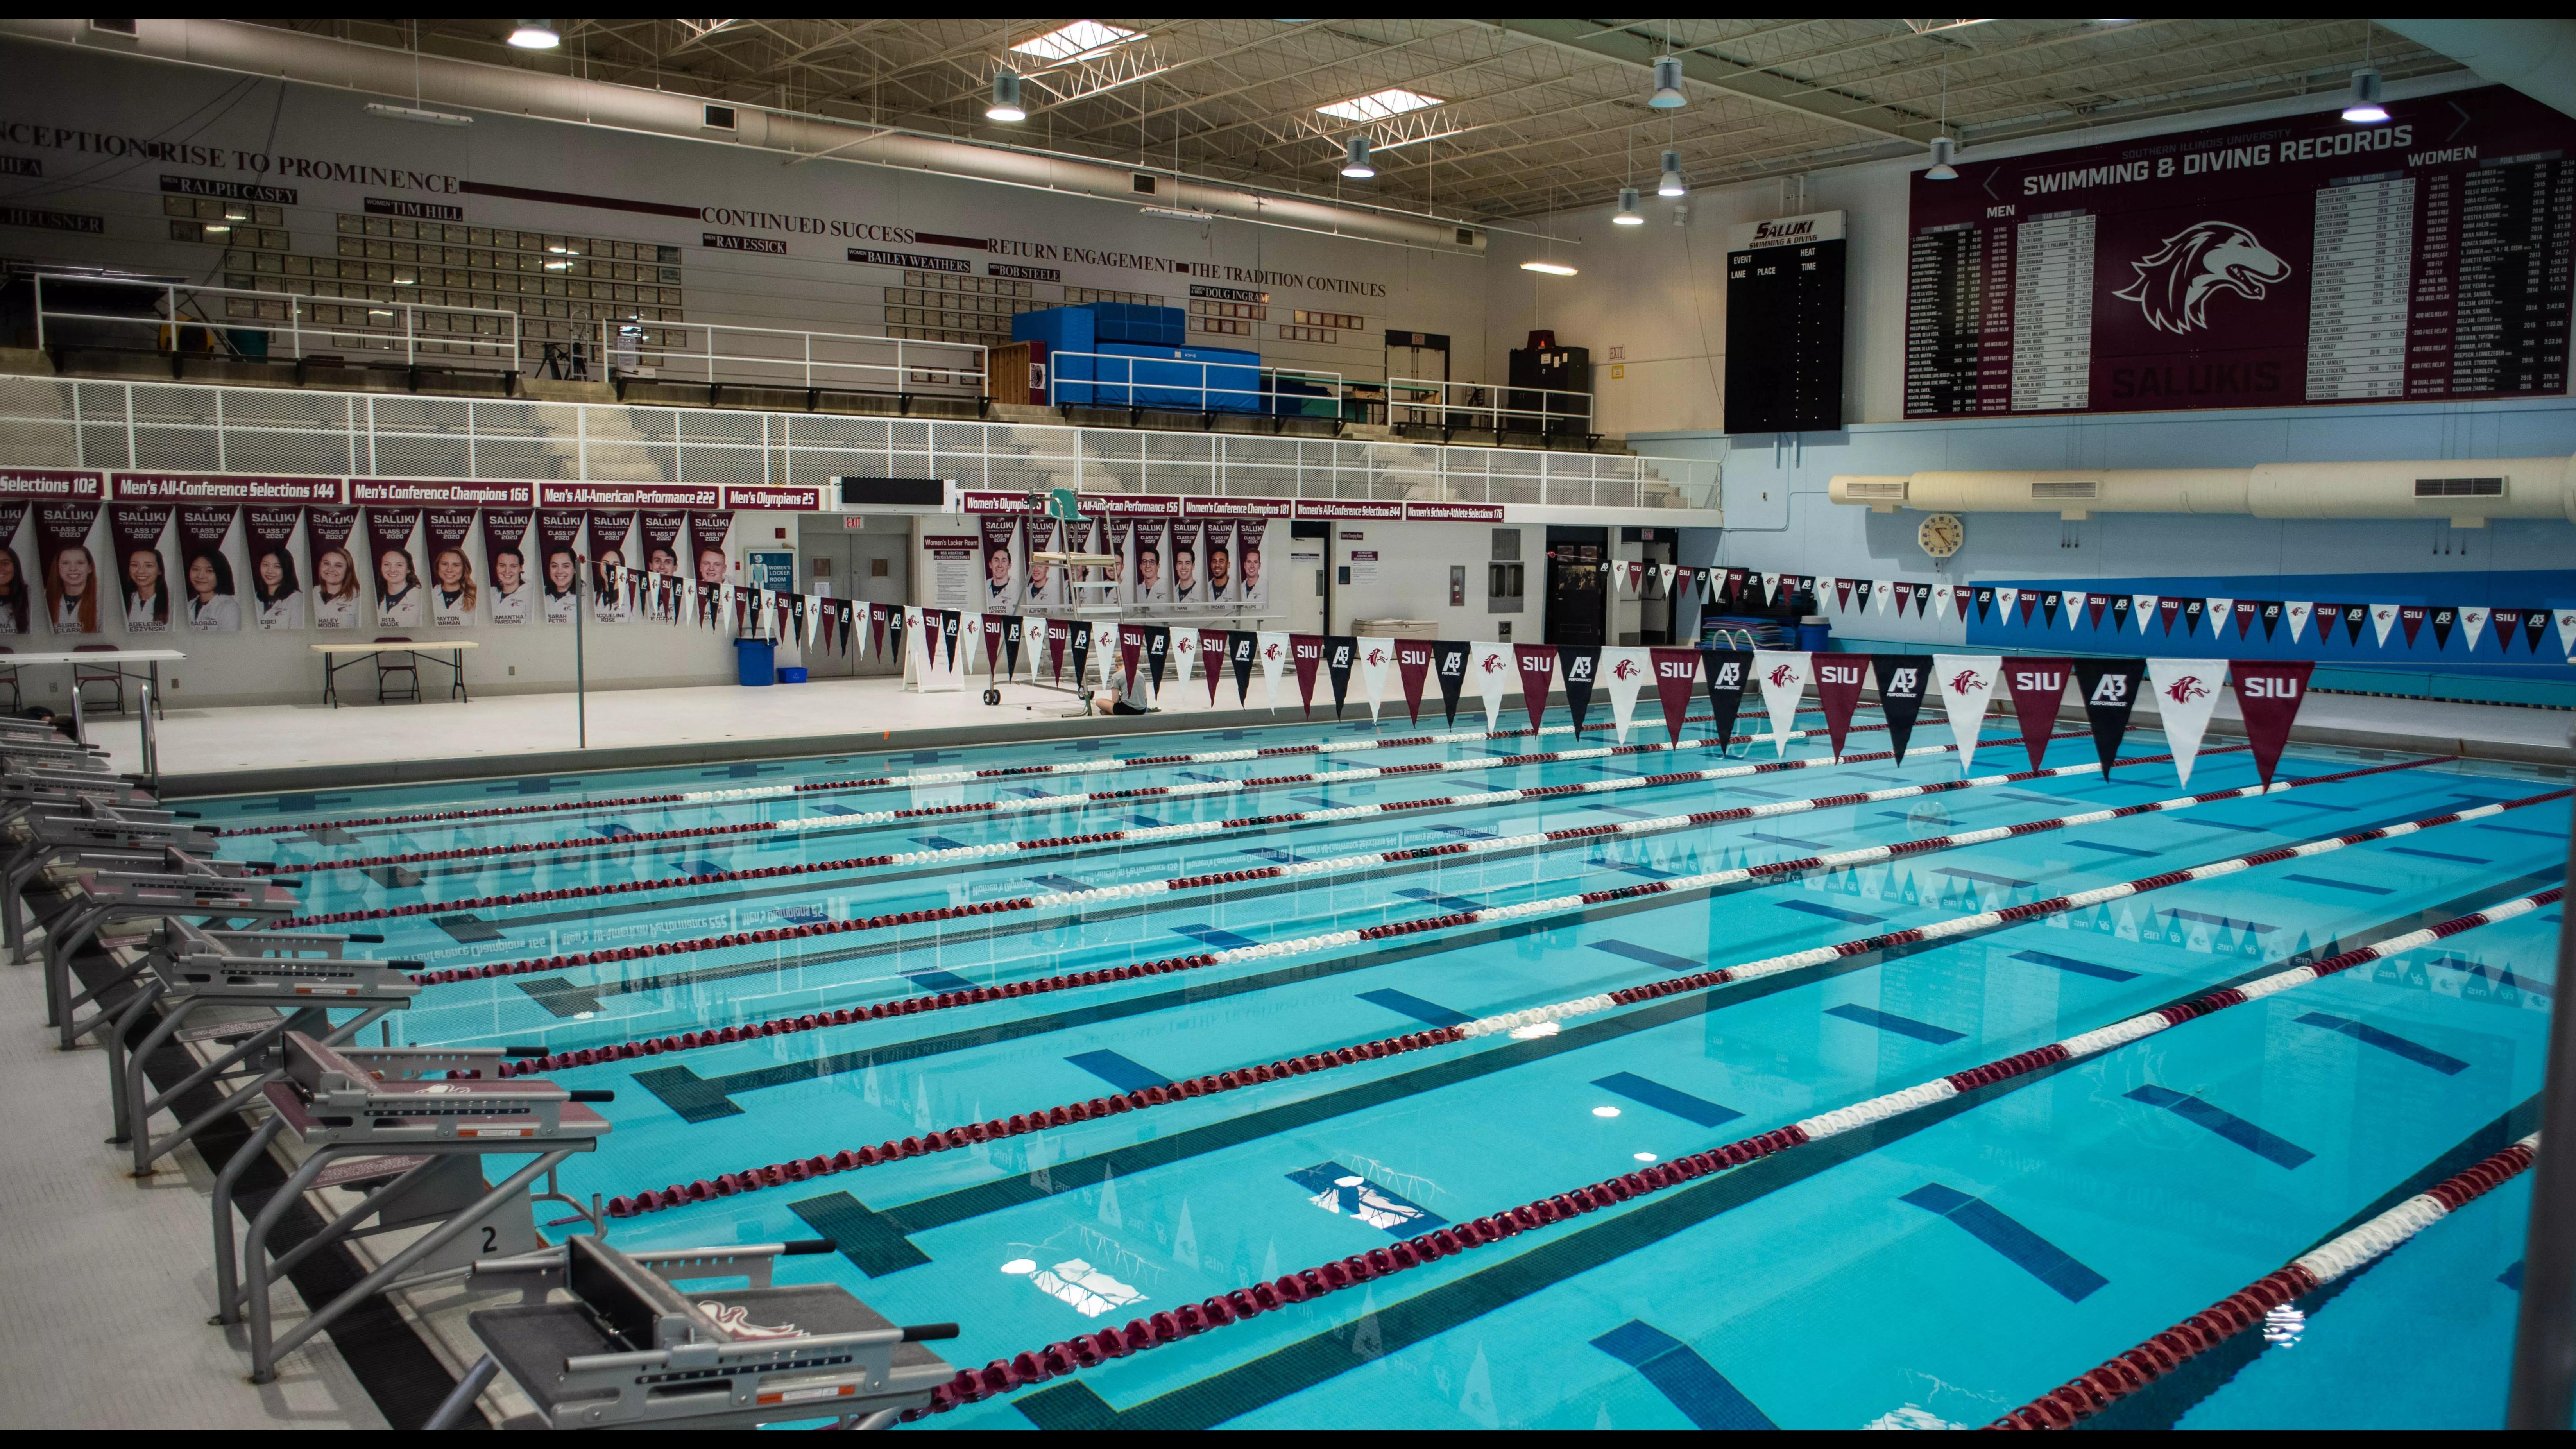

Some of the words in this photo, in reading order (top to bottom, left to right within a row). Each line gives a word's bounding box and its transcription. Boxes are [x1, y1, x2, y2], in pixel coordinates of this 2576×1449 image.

[2122, 144, 2177, 160] SOUTHERN
[2180, 138, 2223, 152] ILLINOIS
[2227, 128, 2292, 146] UNIVERSITY
[2024, 161, 2148, 195] SWIMMING
[2157, 158, 2175, 178] &
[2184, 145, 2270, 175] DIVING
[2280, 125, 2412, 163] RECORDS
[2408, 146, 2477, 167] WOMEN
[2516, 154, 2540, 163] RECORDS
[159, 142, 226, 168] RISE
[232, 150, 270, 173] TO
[278, 156, 458, 194] PROMINENCE
[181, 178, 237, 197] RALPH
[243, 185, 295, 204] CASEY
[391, 202, 421, 217] TIM
[426, 206, 461, 220] HILL
[1987, 205, 2015, 218] MEN
[11, 210, 99, 231] HEUSNER
[702, 207, 825, 234] CONTINUED
[831, 220, 915, 244] SUCCESS
[1753, 220, 1815, 240] SALUKI
[716, 236, 739, 249] RAY
[743, 239, 785, 253] ESSICK
[1749, 238, 1784, 249] SWIMMING
[1794, 235, 1817, 244] DIVING
[987, 238, 1058, 261] RETURN
[1063, 248, 1176, 274] ENGAGEMENT
[1733, 255, 1752, 264] EVENT
[1800, 248, 1815, 257] HEAT
[868, 251, 908, 266] BAILEY
[909, 256, 970, 272] WEATHERS
[1801, 262, 1816, 271] TIME
[1000, 265, 1020, 277] BOB
[1021, 267, 1060, 282] STEELE
[1190, 262, 1221, 279] THE
[1226, 266, 1304, 288] TRADITION
[1307, 274, 1386, 297] CONTINUES
[1731, 270, 1746, 279] LANE
[1757, 267, 1776, 276] PLACE
[1206, 288, 1230, 299] DOUG
[1232, 291, 1270, 304] INGRAM
[1414, 335, 1423, 343] EXIT
[1609, 346, 1624, 360] EXIT
[2111, 360, 2282, 398] SALUKIS
[0, 474, 69, 493] Selections
[73, 478, 97, 493] 102
[120, 479, 157, 495] Men's
[159, 480, 248, 496] All-Conference
[249, 482, 310, 498] Selections
[313, 484, 335, 498] 144
[355, 484, 387, 499] Men's
[389, 485, 449, 500] Conference
[451, 486, 507, 503] Champions
[510, 487, 529, 502] 166
[545, 489, 573, 502] Men's
[574, 489, 635, 503] All-American
[636, 490, 695, 504] Performance
[697, 491, 715, 505] 222
[730, 491, 755, 504] Men's
[757, 492, 801, 507] Olympians
[802, 492, 815, 505] 25
[967, 497, 999, 509] Women's
[1000, 498, 1036, 512] Olympia
[1083, 500, 1122, 512] All-American
[1124, 502, 1165, 512] Performance
[1166, 502, 1178, 512] 156
[1186, 502, 1214, 513] Women's
[1214, 503, 1248, 514] Conference
[1248, 503, 1279, 516] Champions
[1280, 504, 1289, 514] 181
[1298, 504, 1322, 515] Women's
[1323, 505, 1361, 516] All-Conference
[1362, 506, 1389, 516] Selections
[1389, 507, 1400, 516] 244
[44, 510, 94, 520] SALUKI
[374, 515, 415, 523] SALUKI
[847, 516, 861, 528] EXIT
[1407, 509, 1430, 518] Women's
[1430, 509, 1467, 518] Scholar-Athlete
[1468, 510, 1493, 519] Selections
[1493, 510, 1503, 519] 176
[2495, 613, 2515, 622] SIU
[1124, 632, 1141, 646] SIU
[1203, 639, 1223, 652] SIU
[1402, 651, 1426, 664] SIU
[1523, 656, 1550, 672] SIU
[1569, 656, 1592, 677] A3
[1660, 662, 1692, 679] SIU
[1821, 666, 1858, 684] SIU
[1888, 668, 1917, 693] A3
[2016, 672, 2060, 691] SIU
[2091, 673, 2127, 700] A3
[2245, 677, 2297, 699] SIU
[482, 1226, 498, 1253] 2
